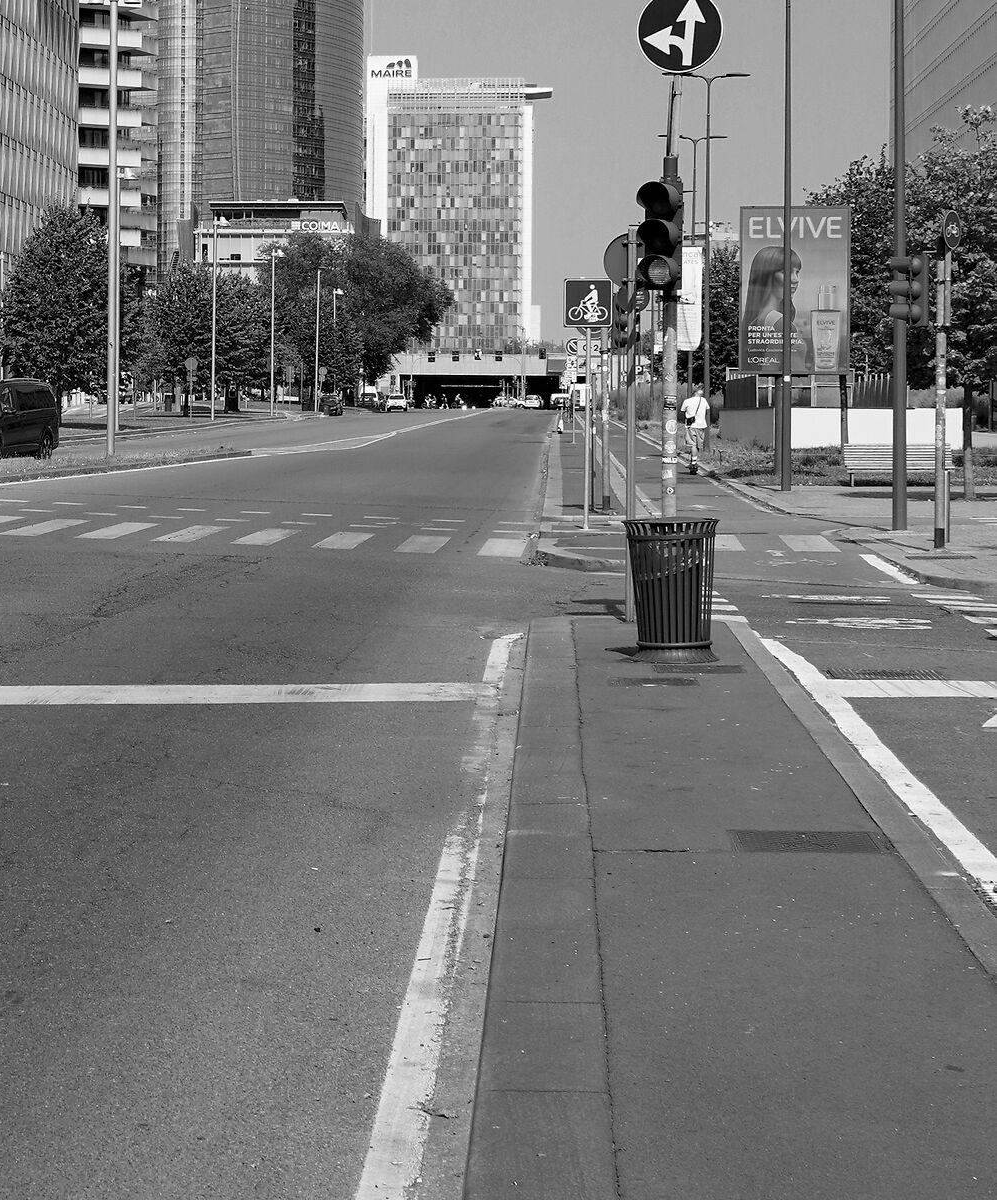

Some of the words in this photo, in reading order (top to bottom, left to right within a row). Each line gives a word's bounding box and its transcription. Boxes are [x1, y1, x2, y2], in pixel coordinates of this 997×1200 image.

[371, 69, 412, 78] MAIRE
[301, 221, 340, 231] COIMA
[749, 216, 842, 239] ELVIVE
[635, 366, 643, 374] P
